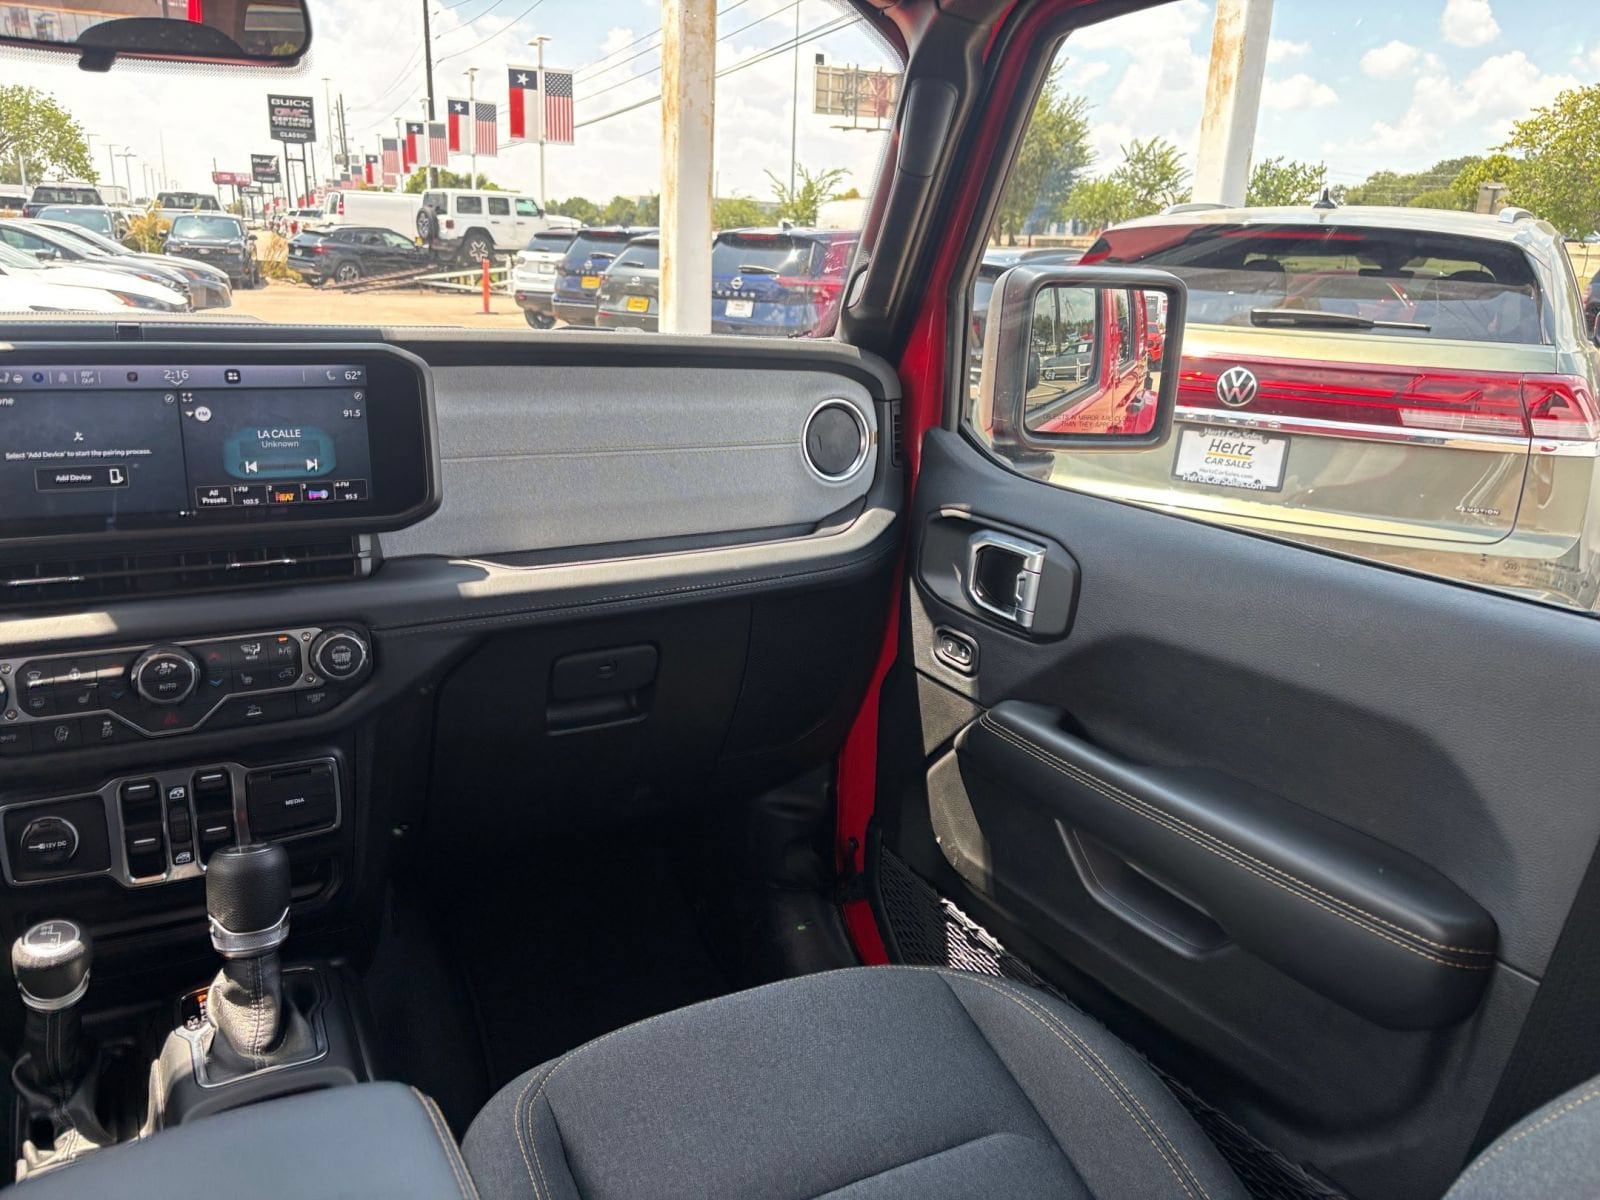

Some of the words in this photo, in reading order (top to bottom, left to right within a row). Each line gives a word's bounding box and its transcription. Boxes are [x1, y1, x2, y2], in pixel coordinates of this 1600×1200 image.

[271, 98, 311, 107] BUICK
[163, 369, 189, 379] 2:16
[344, 370, 361, 380] 62°
[343, 409, 361, 417] 91.5
[257, 430, 270, 439] LA
[271, 429, 301, 439] CALLE
[261, 440, 299, 449] Unknown
[1208, 438, 1256, 457] Hertz
[1204, 456, 1224, 466] CAR
[1224, 459, 1254, 469] SALES
[70, 474, 92, 482] Device
[285, 797, 305, 806] MEDIA
